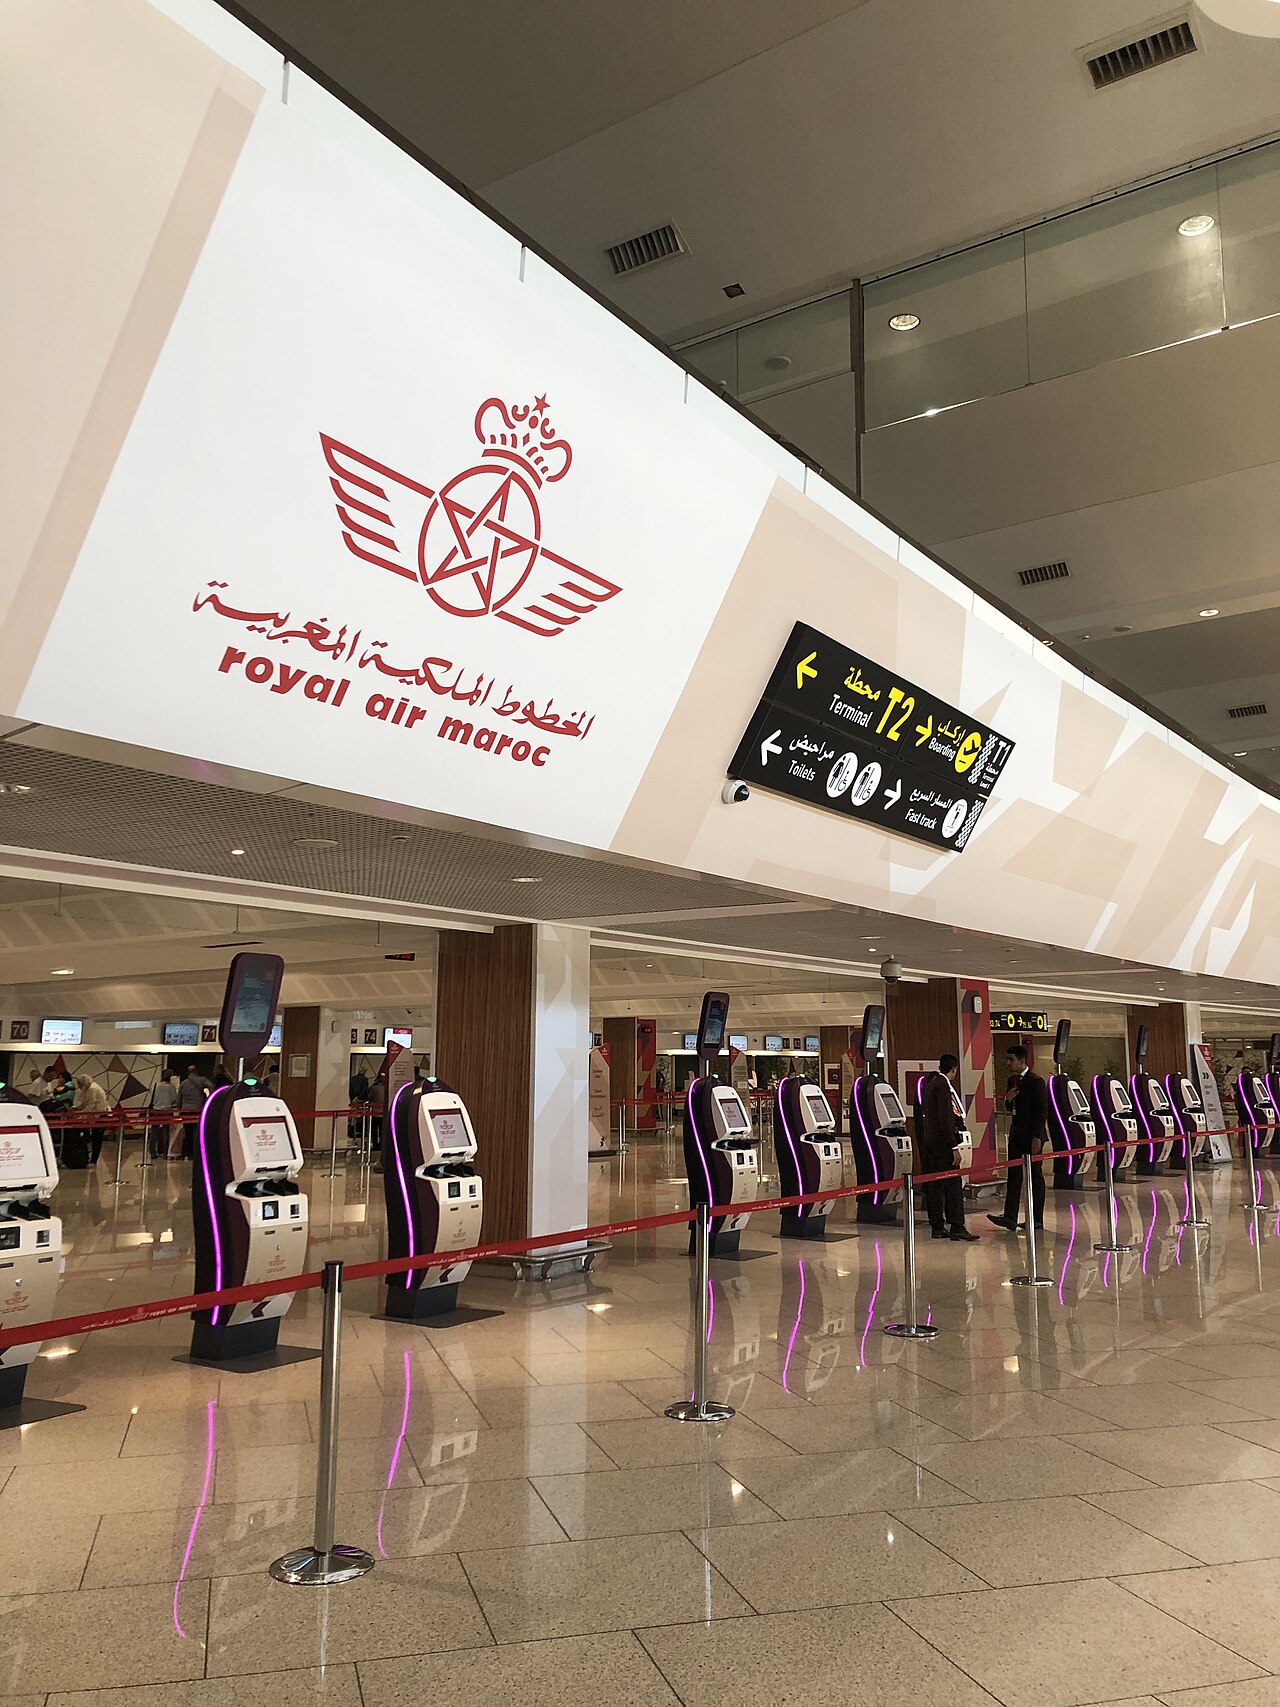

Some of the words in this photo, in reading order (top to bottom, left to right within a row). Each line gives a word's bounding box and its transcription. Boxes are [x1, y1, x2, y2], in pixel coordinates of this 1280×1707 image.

[193, 580, 361, 663] المغربية
[358, 640, 495, 706] الملكية
[843, 666, 881, 701] محطة
[217, 645, 351, 707] royal
[365, 693, 427, 729] air
[437, 715, 552, 767] maroc
[491, 685, 596, 741] الخطوط
[829, 693, 873, 728] Terminal
[875, 686, 915, 742] T2
[788, 734, 835, 761] مراحيض
[928, 737, 956, 761] Boarding
[992, 740, 1012, 767] T1
[788, 759, 816, 781] Toilets
[904, 808, 922, 824] Fast
[919, 814, 937, 830] track
[12, 1024, 28, 1037] 70
[203, 1028, 216, 1040] 71
[365, 1031, 376, 1042] 74
